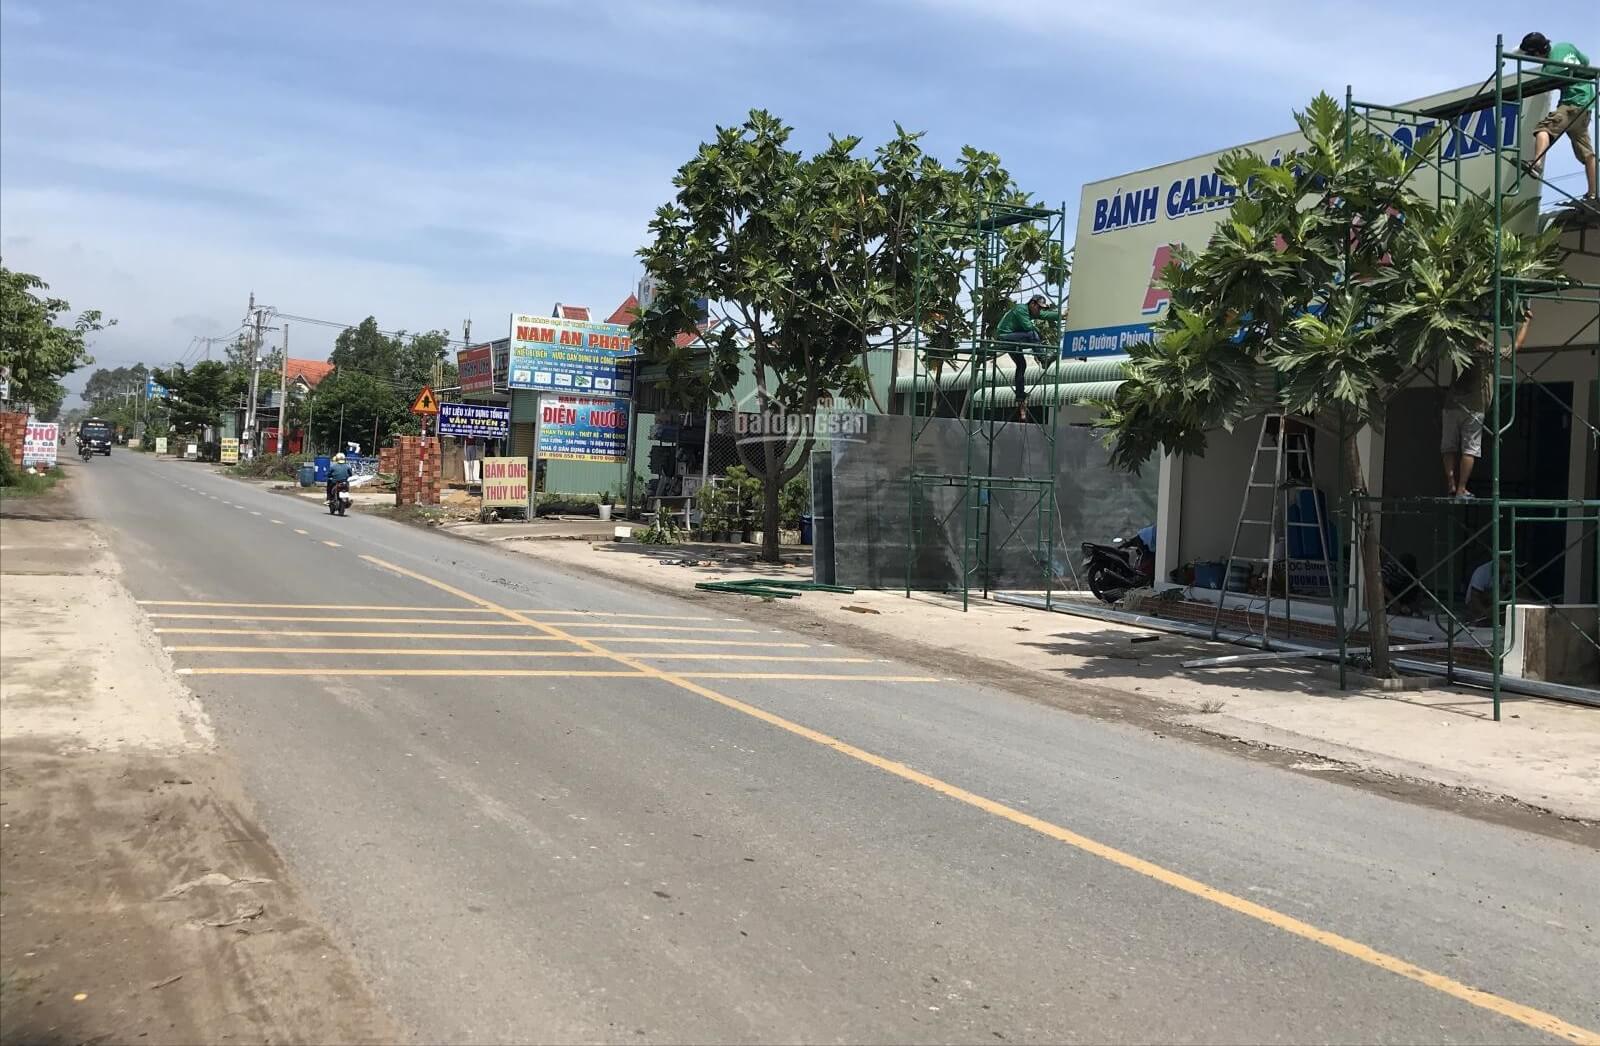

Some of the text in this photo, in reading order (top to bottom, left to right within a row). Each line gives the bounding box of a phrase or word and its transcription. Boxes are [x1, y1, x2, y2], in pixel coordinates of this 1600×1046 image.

[1092, 187, 1159, 235] BÁNH
[1166, 174, 1238, 219] CANH
[517, 325, 556, 344] NAM
[560, 330, 583, 347] AN
[1072, 336, 1087, 352] ĐC:
[1088, 333, 1118, 351] Đường
[442, 405, 452, 417] VẬT
[452, 407, 463, 417] LIỆU
[464, 408, 474, 417] XÂY
[475, 409, 489, 419] DỰNG
[543, 404, 576, 427] ĐIỆN
[590, 408, 627, 429] NƯỚC
[26, 423, 57, 441] PHỞ
[508, 459, 526, 478] ỐNG
